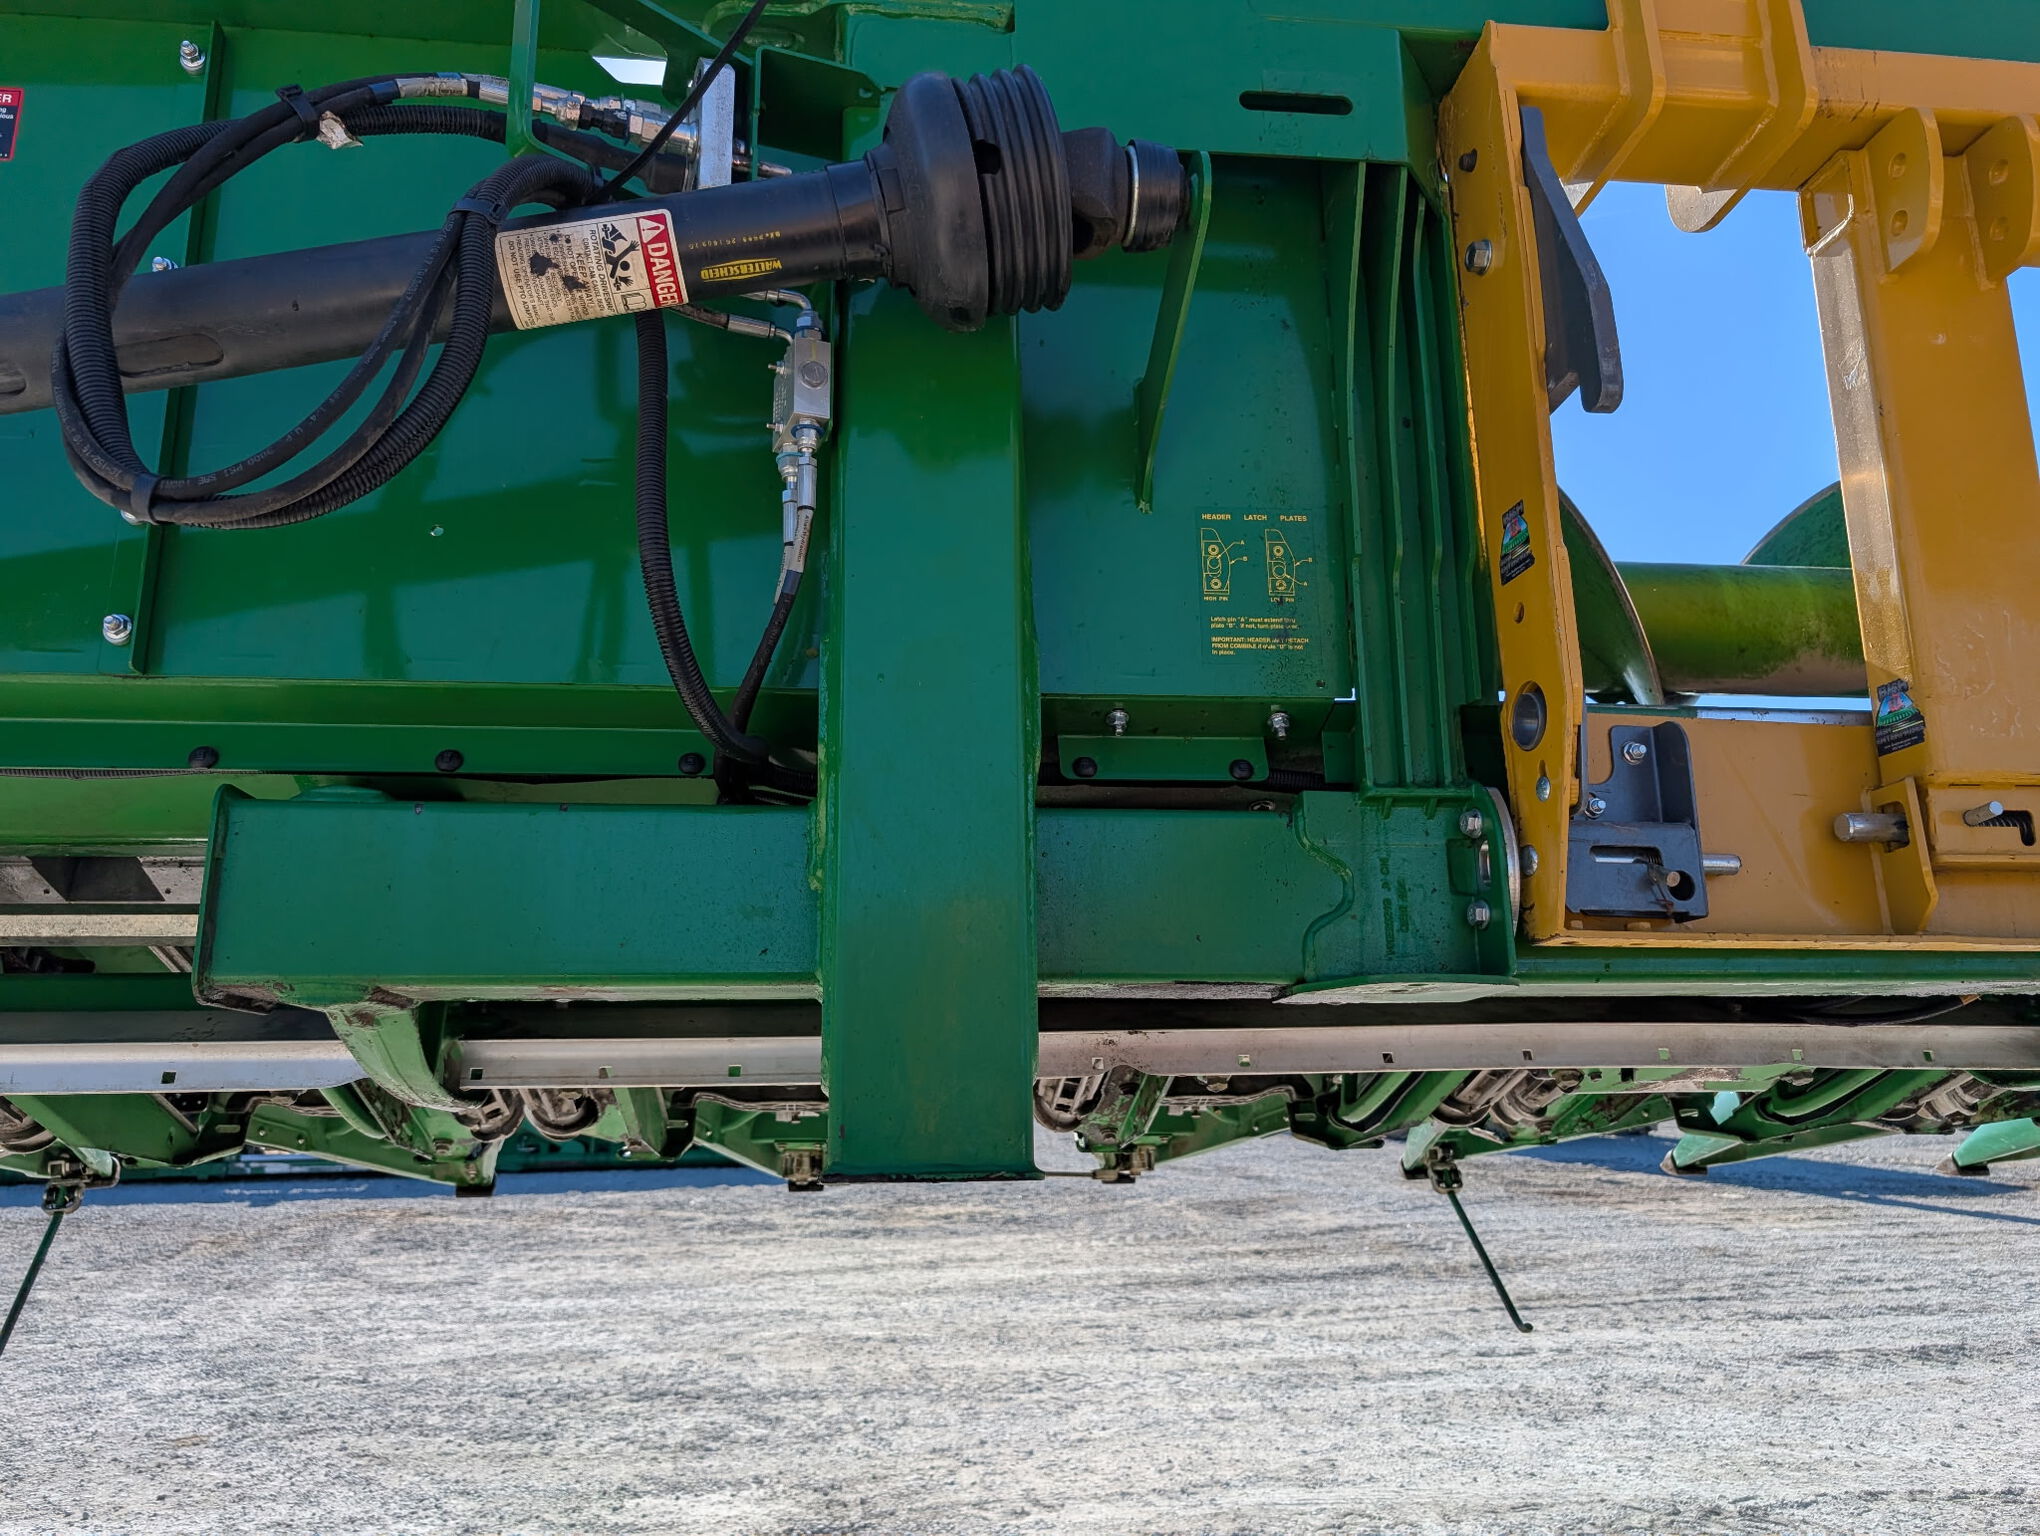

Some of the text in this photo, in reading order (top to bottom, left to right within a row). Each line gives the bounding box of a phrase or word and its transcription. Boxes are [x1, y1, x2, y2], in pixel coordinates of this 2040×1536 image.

[508, 240, 514, 250] DO
[514, 268, 522, 283] USE
[518, 285, 526, 298] PTO
[515, 239, 524, 264] READING
[576, 252, 586, 277] KEEP
[582, 238, 592, 264] CONTACT
[592, 280, 600, 297] CAUSE
[589, 229, 603, 270] ROTATING
[699, 259, 782, 279] WALTERSCHEID
[647, 242, 677, 306] DANGER
